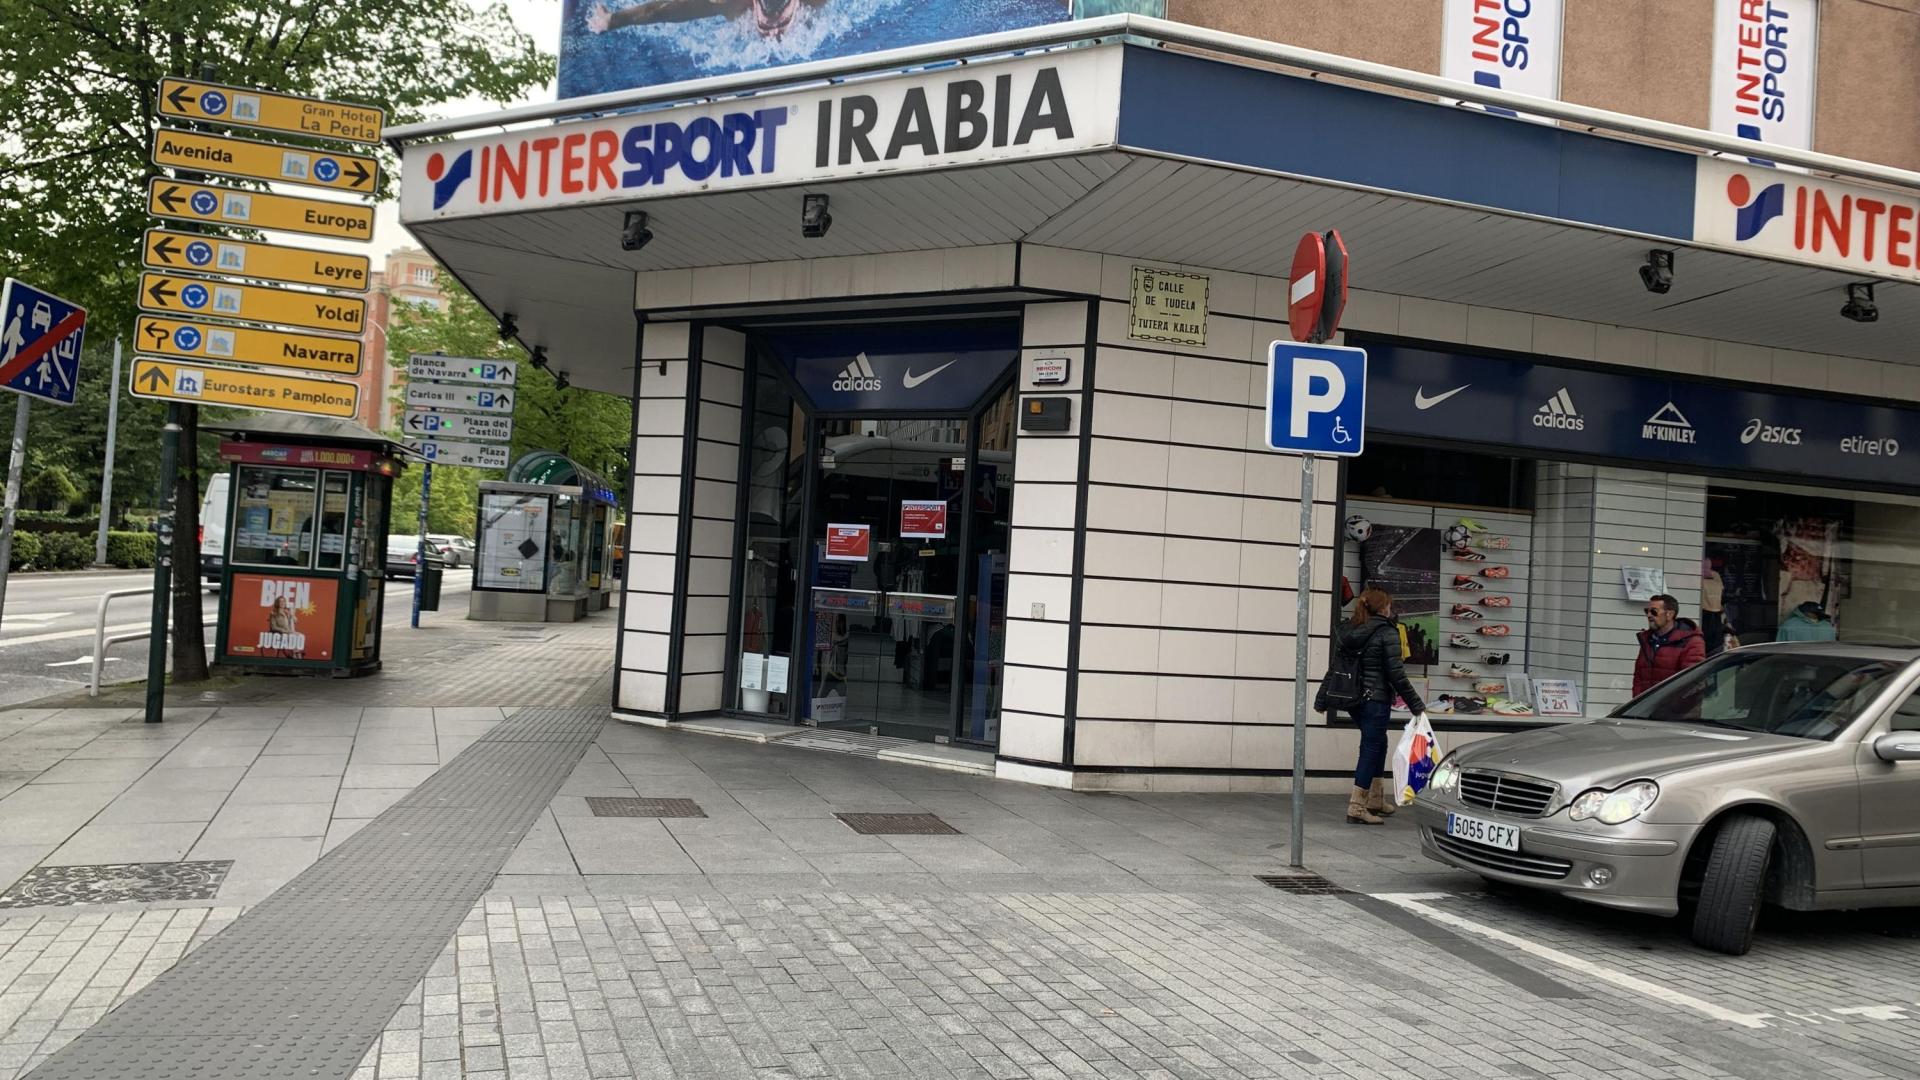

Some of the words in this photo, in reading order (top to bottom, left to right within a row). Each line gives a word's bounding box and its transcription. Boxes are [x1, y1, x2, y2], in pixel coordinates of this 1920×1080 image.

[1762, 1, 1789, 123] SPORT
[303, 103, 334, 118] Gran
[340, 108, 377, 124] Hotel
[301, 116, 320, 131] La
[330, 120, 375, 139] Perla
[478, 106, 788, 205] INTERSPORT
[815, 66, 1074, 169] IRABIA
[161, 141, 233, 164] Avenida
[305, 209, 367, 231] Europa
[1793, 184, 1920, 271] INTE
[314, 261, 363, 280] Leyre
[1158, 281, 1184, 294] CALLE
[1145, 295, 1156, 306] DE
[1165, 298, 1196, 311] TUDELA
[315, 304, 359, 323] Yoldi
[1138, 318, 1168, 332] TUTERA
[1173, 321, 1199, 335] KALEA
[283, 343, 354, 364] Navarra
[412, 357, 446, 368] Blanca
[412, 367, 424, 375] de
[427, 368, 467, 378] Navarra
[204, 379, 276, 398] Eurostars
[283, 388, 352, 407] Pamplona
[832, 377, 882, 392] adidas
[410, 390, 442, 399] Carlos
[445, 390, 455, 400] III
[1290, 357, 1346, 438] P
[463, 416, 489, 427] Plaza
[493, 419, 508, 428] del
[1532, 411, 1584, 431] adidas
[468, 427, 508, 438] Castillo
[479, 447, 506, 457] Plaza
[1840, 434, 1884, 456] etirel
[461, 455, 474, 463] de
[477, 456, 505, 466] Toros
[260, 579, 311, 610] BIEN
[257, 632, 306, 650] JUGADO
[1455, 816, 1484, 840] 5055
[1488, 825, 1514, 847] CFX
